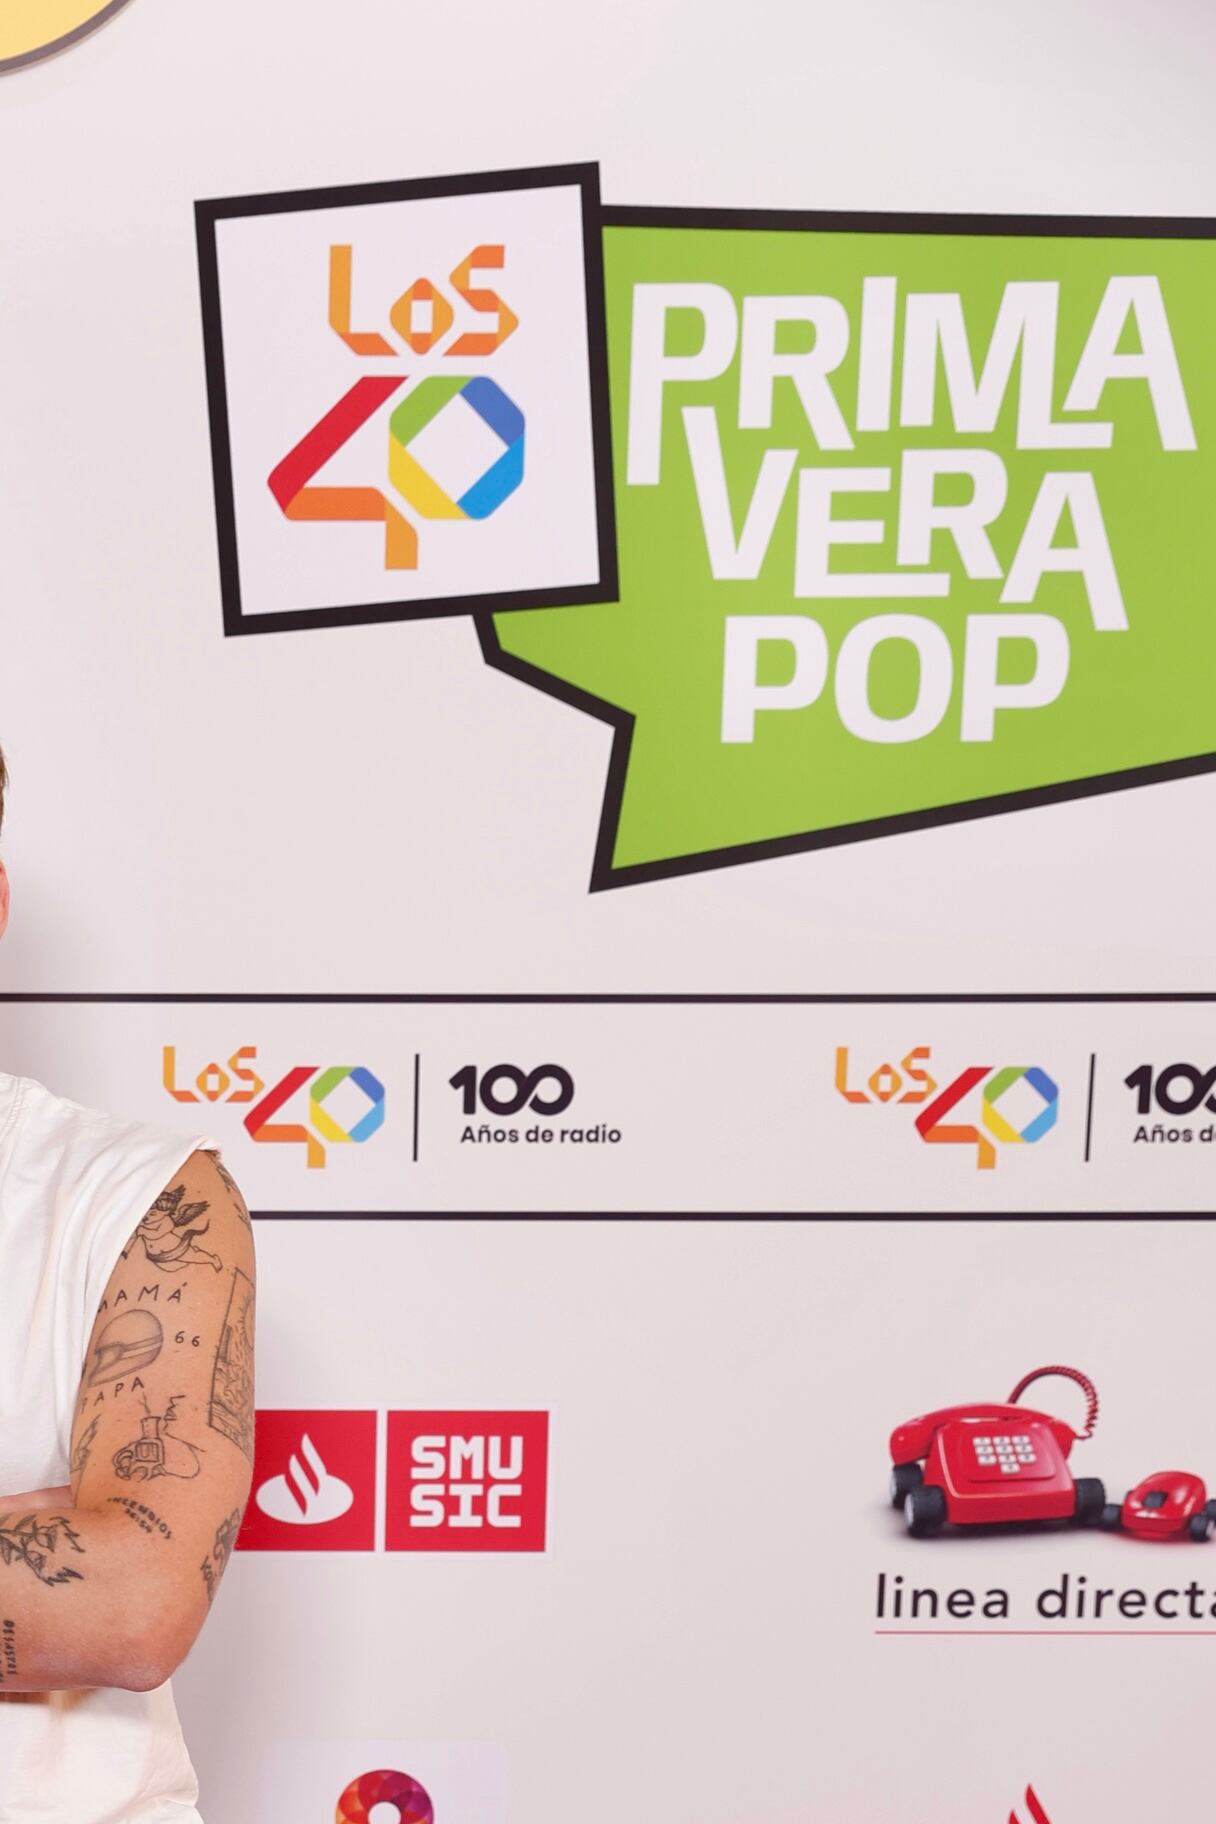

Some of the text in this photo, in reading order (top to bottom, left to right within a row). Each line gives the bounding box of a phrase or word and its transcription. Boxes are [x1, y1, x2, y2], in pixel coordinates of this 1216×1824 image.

[627, 275, 1197, 486] PRIMA
[267, 375, 525, 570] 40
[681, 406, 1130, 631] VERA
[721, 613, 1071, 743] POP
[243, 1065, 385, 1169] 40
[449, 1064, 576, 1118] 100
[915, 1066, 1059, 1169] 40
[461, 1125, 623, 1145] Años de radio
[1133, 1124, 1216, 1143] Años d
[411, 1435, 525, 1481] SMU
[410, 1483, 523, 1529] SIC
[877, 1573, 1216, 1620] linea direct
